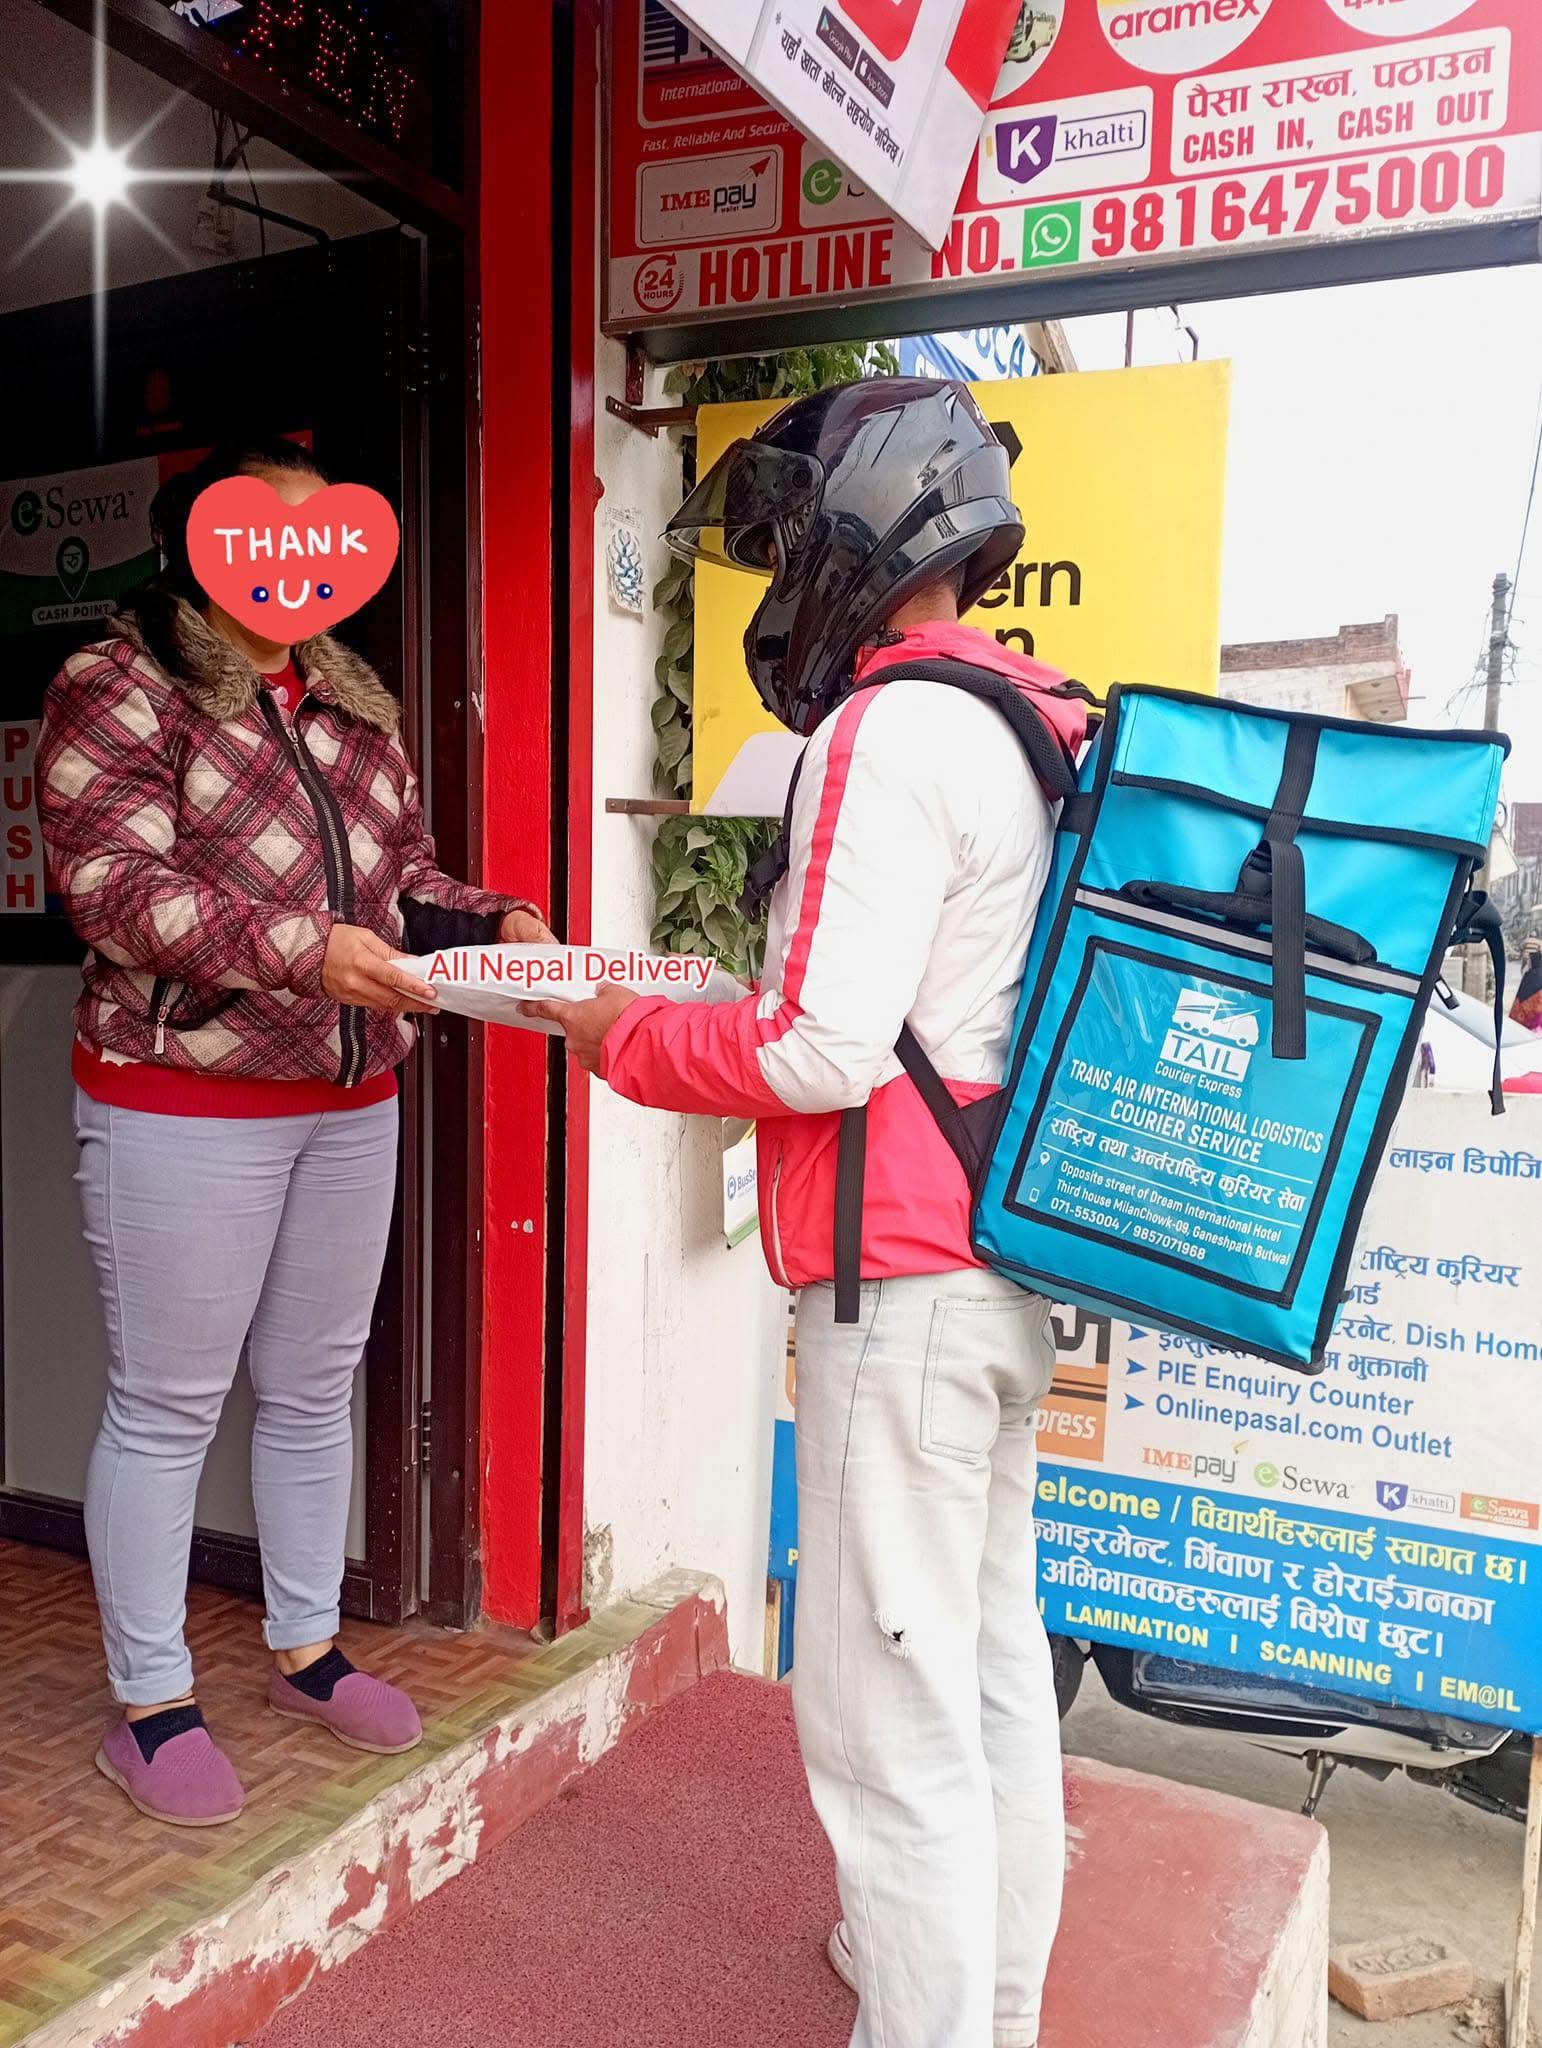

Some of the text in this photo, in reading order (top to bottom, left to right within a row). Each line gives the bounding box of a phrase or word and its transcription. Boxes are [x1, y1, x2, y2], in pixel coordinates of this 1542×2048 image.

[1110, 0, 1260, 40] aramex
[660, 78, 741, 101] International
[1187, 83, 1251, 118] पैसा
[1373, 46, 1495, 89] पठाउन
[642, 121, 790, 153] Fast, Reliable And Secure
[1010, 120, 1133, 169] K khalti
[1183, 89, 1493, 163] CASH IN, CASH OUT
[660, 183, 756, 213] IME pay
[698, 145, 1505, 306] HOTLINE NO. 9816475000
[643, 290, 674, 300] HOURS
[644, 269, 674, 291] 24
[37, 607, 69, 622] CASH
[4, 728, 35, 908] PUSH
[1172, 1034, 1239, 1076] TAIL
[1155, 1061, 1242, 1099] Courier Express
[1070, 1058, 1323, 1153] TRANS AIR INTERNATIONAL LOGISTICS
[1110, 1099, 1263, 1163] COURIER SERVICE
[738, 1168, 757, 1191] BusSe
[1098, 1135, 1129, 1158] तथा
[1218, 1173, 1275, 1205] कुरियर
[1278, 1186, 1307, 1212] सेवा
[1463, 1147, 1542, 1179] डिपोजि
[1057, 1178, 1082, 1198] Third
[1081, 1187, 1112, 1208] house
[1192, 1226, 1253, 1256] Ganeshpath
[1255, 1245, 1291, 1266] Butwal
[1060, 1160, 1282, 1243] Opposite street of Dream International Hotel
[1050, 1197, 1120, 1231] 071-553004
[1132, 1225, 1206, 1260] 9857071968
[1436, 1255, 1522, 1287] कुरियर
[1406, 1322, 1465, 1352] Dish
[1475, 1331, 1542, 1361] Hom
[1158, 1360, 1414, 1416] PIE Enquiry Counter
[1348, 1354, 1429, 1382] भुक्तानी
[1155, 1393, 1452, 1458] Onlinepasal.com Outlet
[1141, 1447, 1236, 1484] IME pay
[1383, 1484, 1449, 1510] K khalti
[1036, 1475, 1161, 1520] elcome
[1384, 1536, 1476, 1576] स्वागत
[1282, 1561, 1305, 1591] र
[1290, 1595, 1370, 1643] विशेष
[1065, 1601, 1209, 1648] LAMINATION
[1259, 1640, 1392, 1685] SCANNING
[1440, 1676, 1521, 1713] EM@IL
